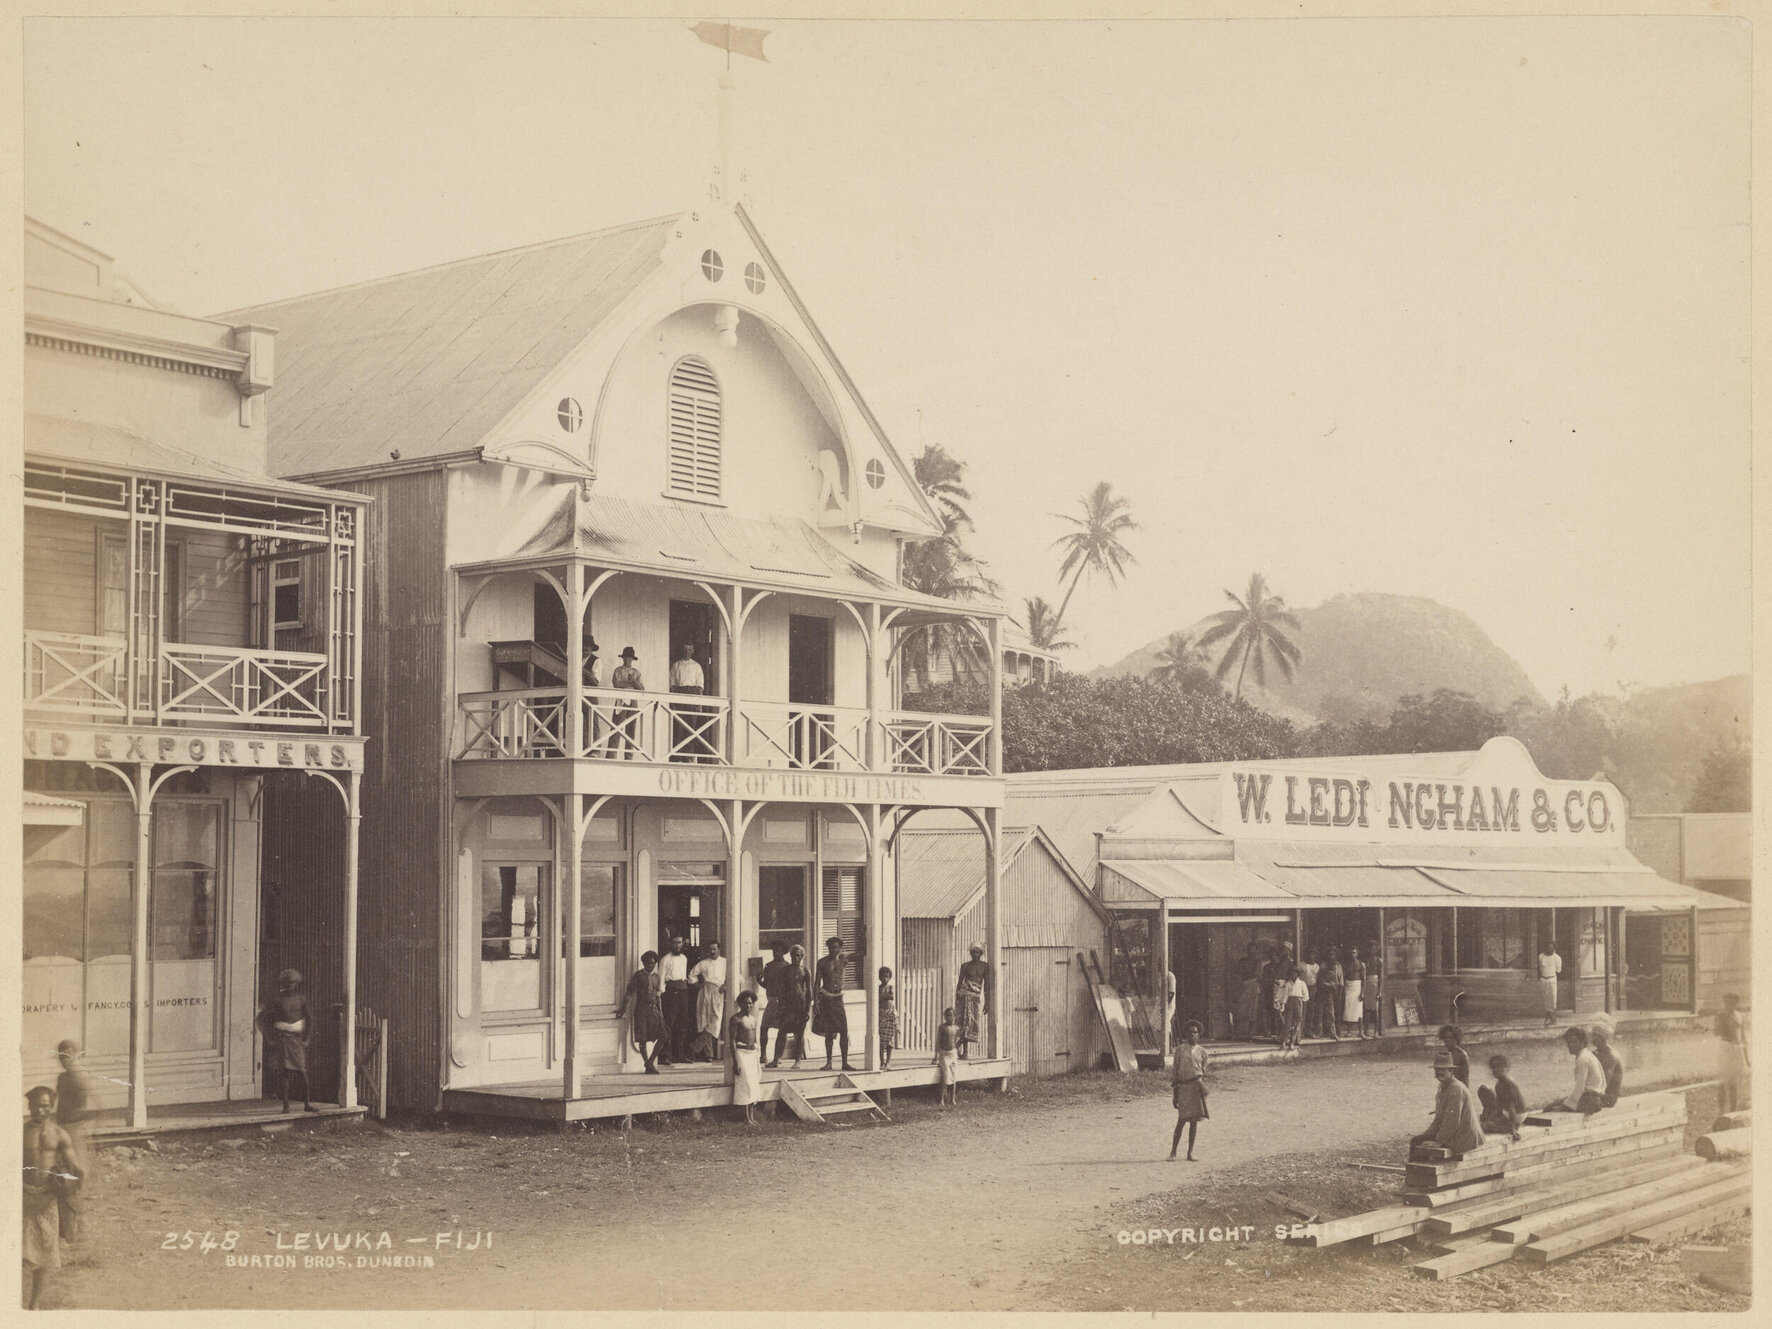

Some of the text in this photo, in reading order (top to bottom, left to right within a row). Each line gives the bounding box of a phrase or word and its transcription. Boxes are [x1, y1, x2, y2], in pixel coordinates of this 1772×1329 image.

[659, 769, 738, 794] OFFICE
[745, 774, 773, 796] OF
[777, 775, 818, 797] THE
[1232, 772, 1273, 824] W.
[1530, 788, 1558, 832] &
[1563, 789, 1615, 834] CO.
[156, 997, 208, 1007] IMPORTERS
